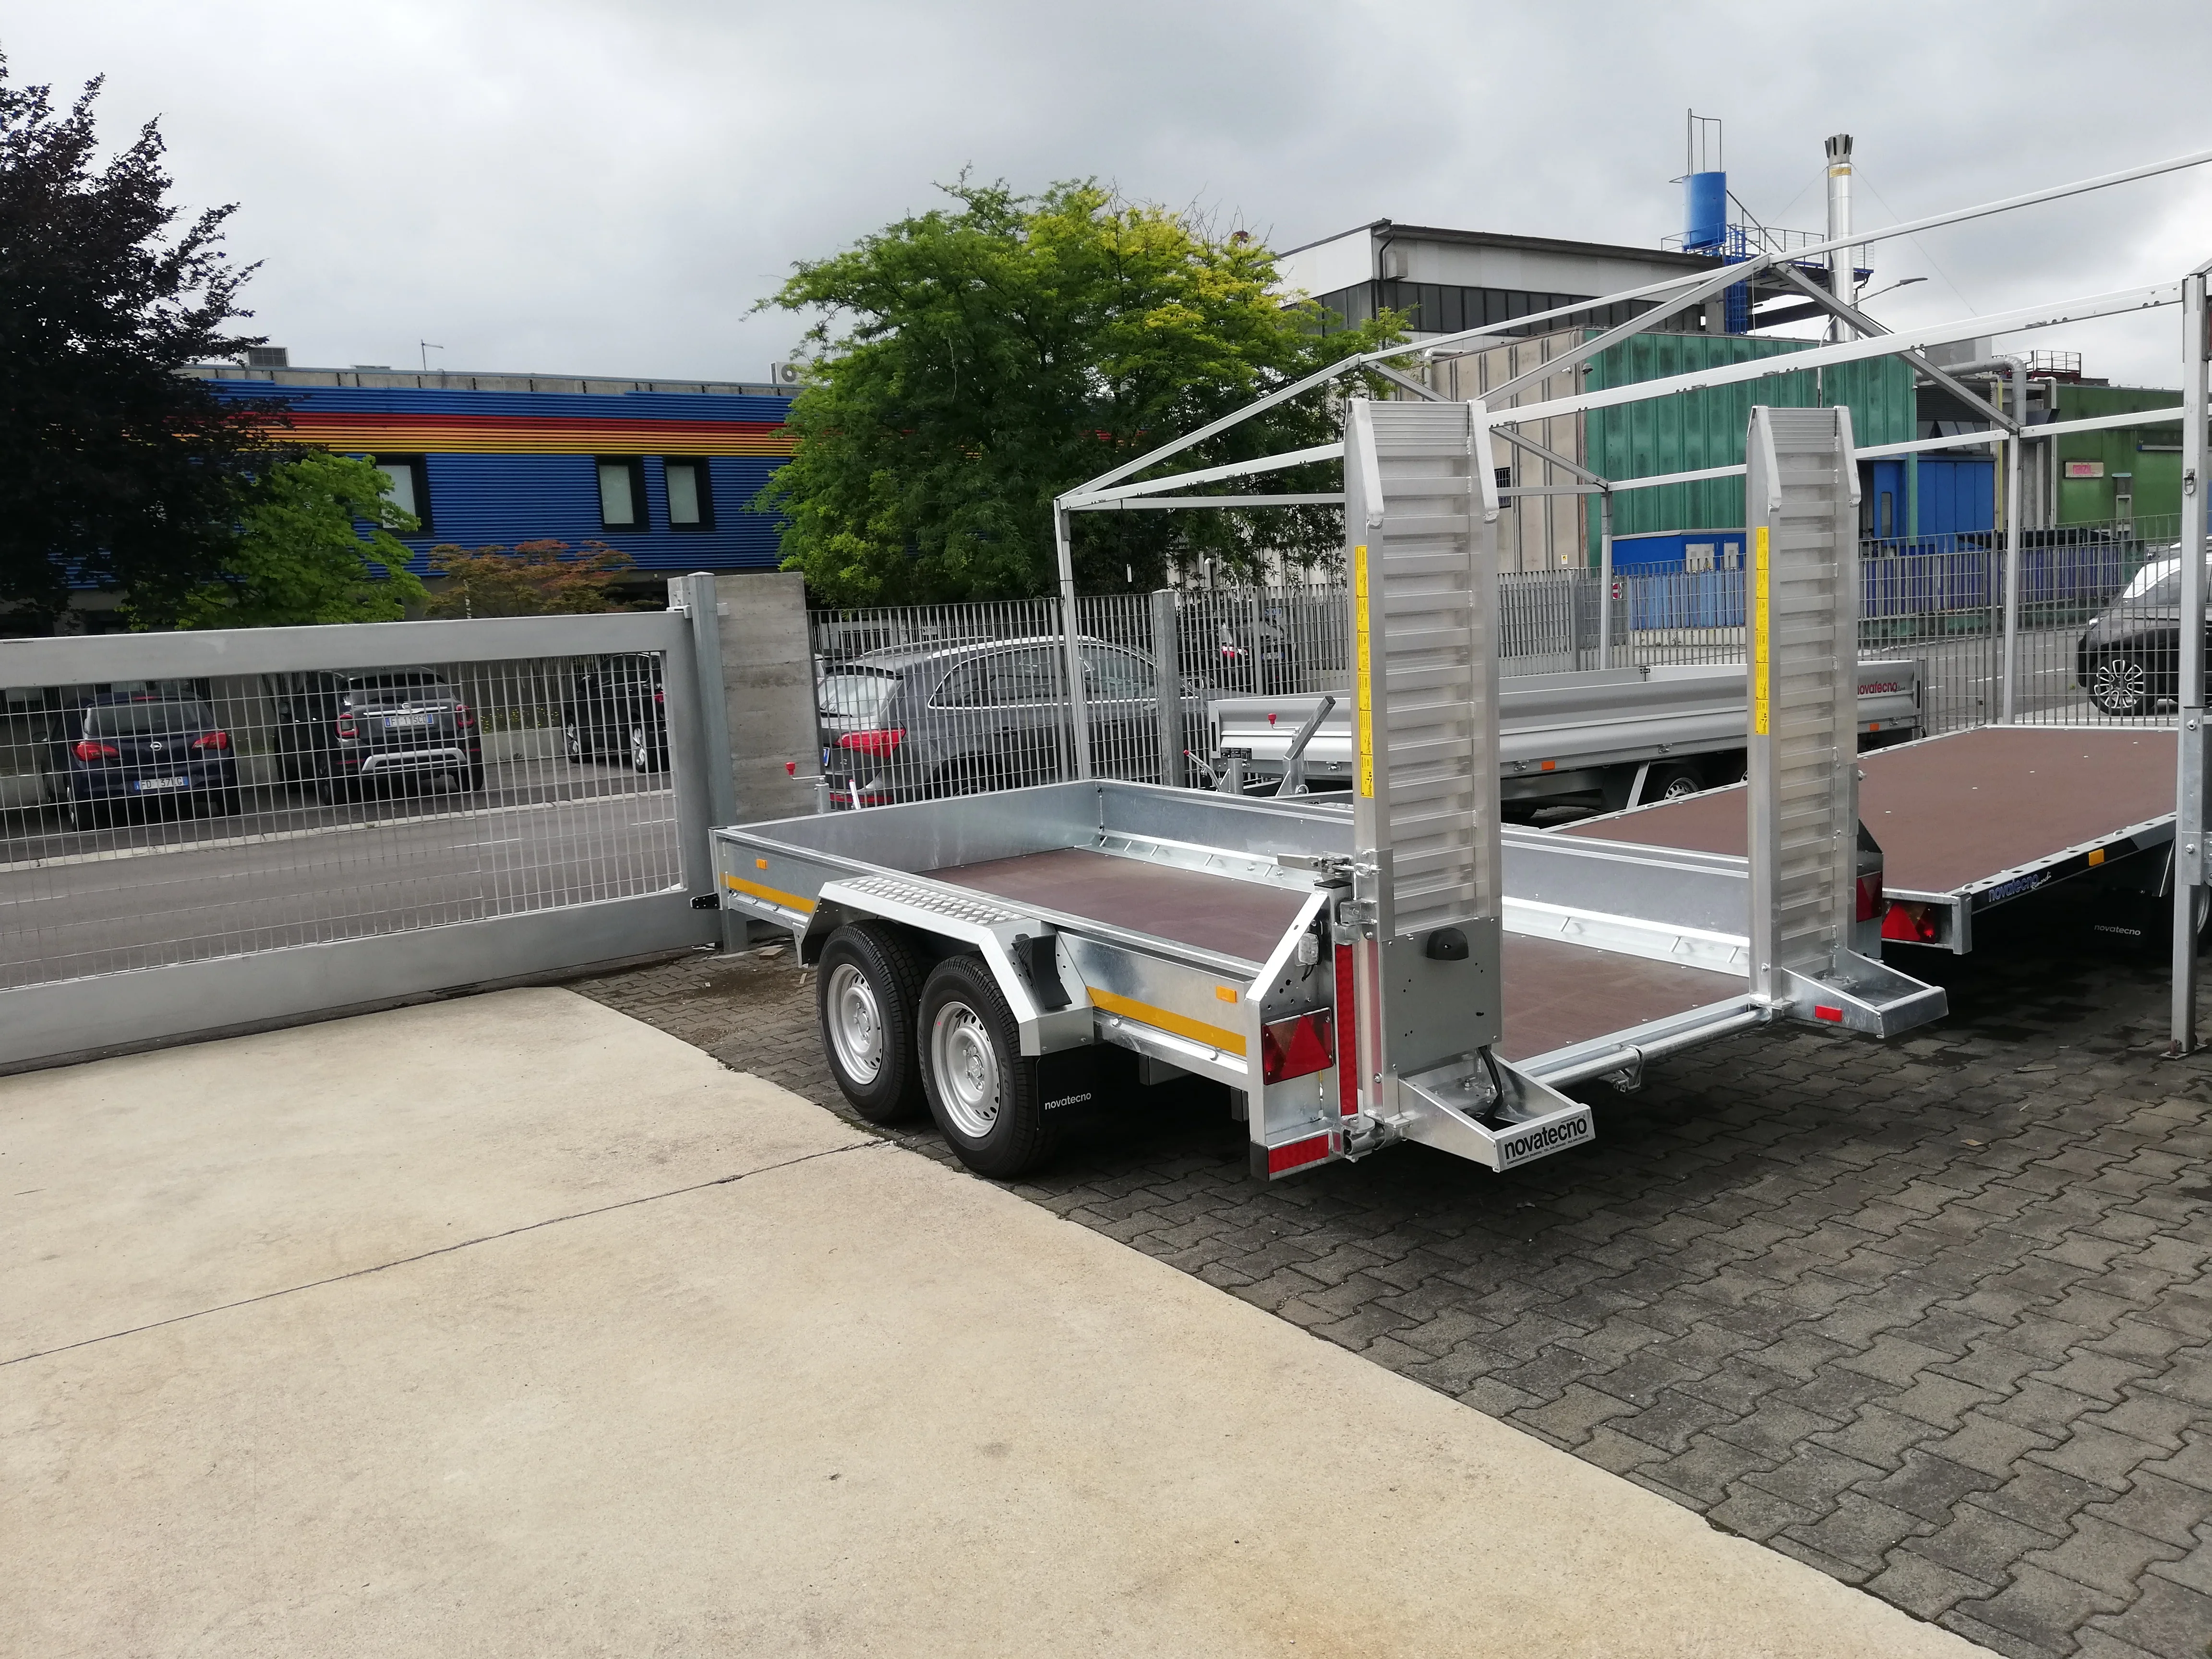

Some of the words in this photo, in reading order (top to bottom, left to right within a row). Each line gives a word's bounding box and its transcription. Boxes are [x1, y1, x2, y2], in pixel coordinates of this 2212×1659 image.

[1857, 681, 1898, 695] ovatecno
[404, 715, 426, 724] 15CD
[156, 777, 182, 788] 37G
[1988, 874, 2039, 902] novatecno
[2094, 925, 2141, 936] novatecno
[1045, 1093, 1092, 1110] novatecno
[1504, 1118, 1587, 1160] novatecno
